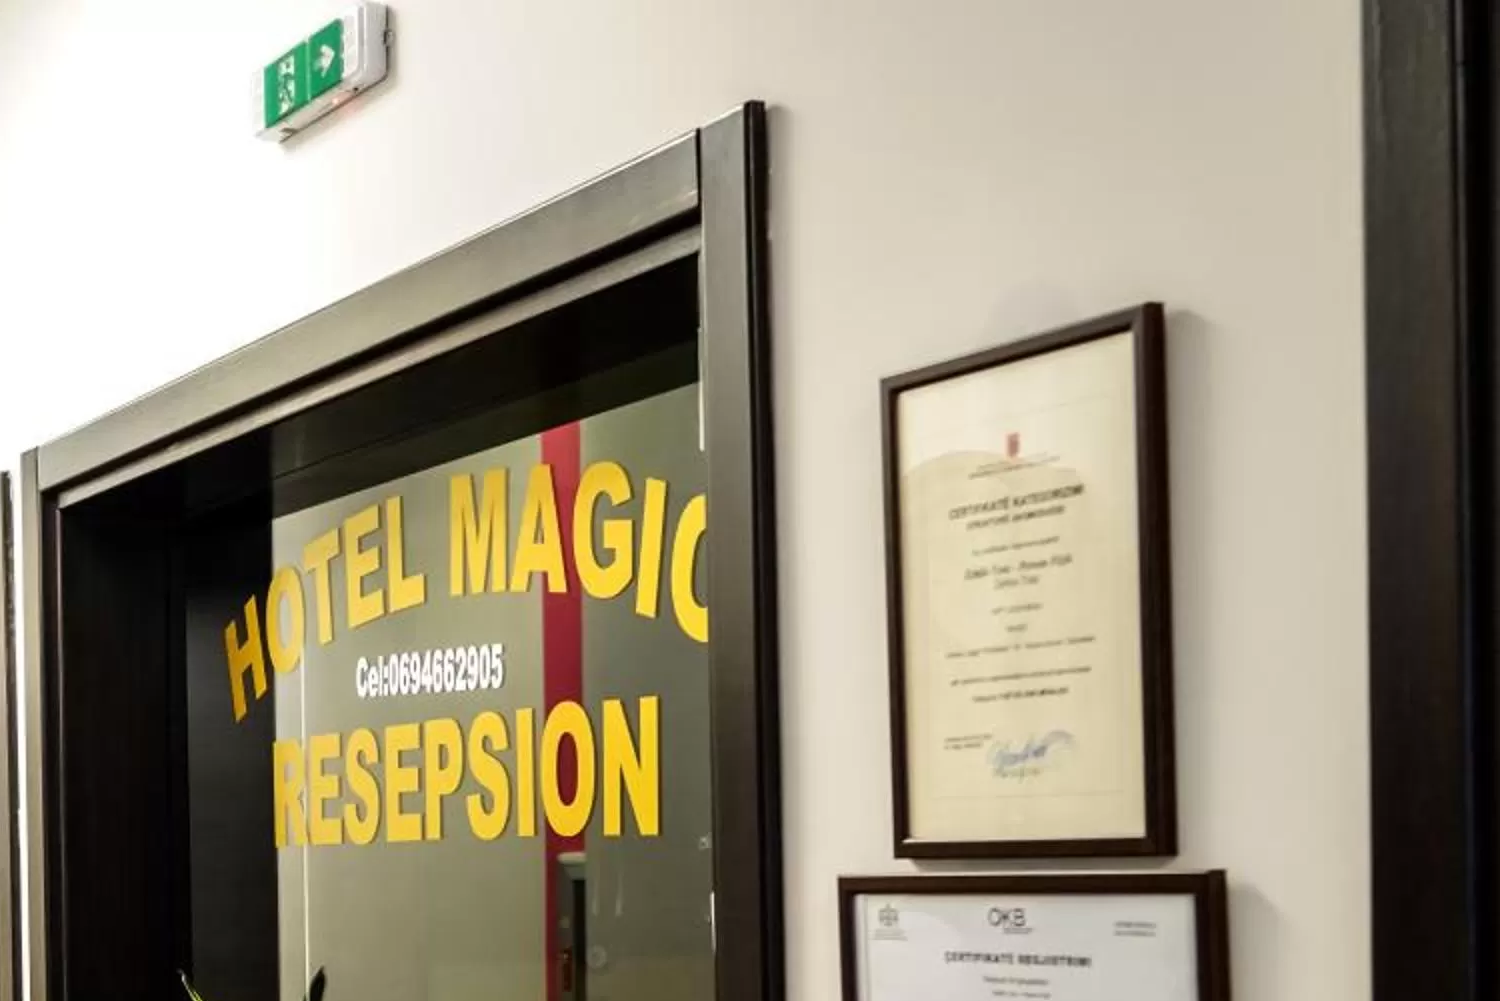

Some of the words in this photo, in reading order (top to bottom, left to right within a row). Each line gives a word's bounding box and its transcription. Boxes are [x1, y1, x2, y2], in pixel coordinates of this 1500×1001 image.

[223, 495, 427, 723] HOTEL
[355, 643, 504, 698] Cel:0694662905
[273, 695, 660, 849] RESEPSION
